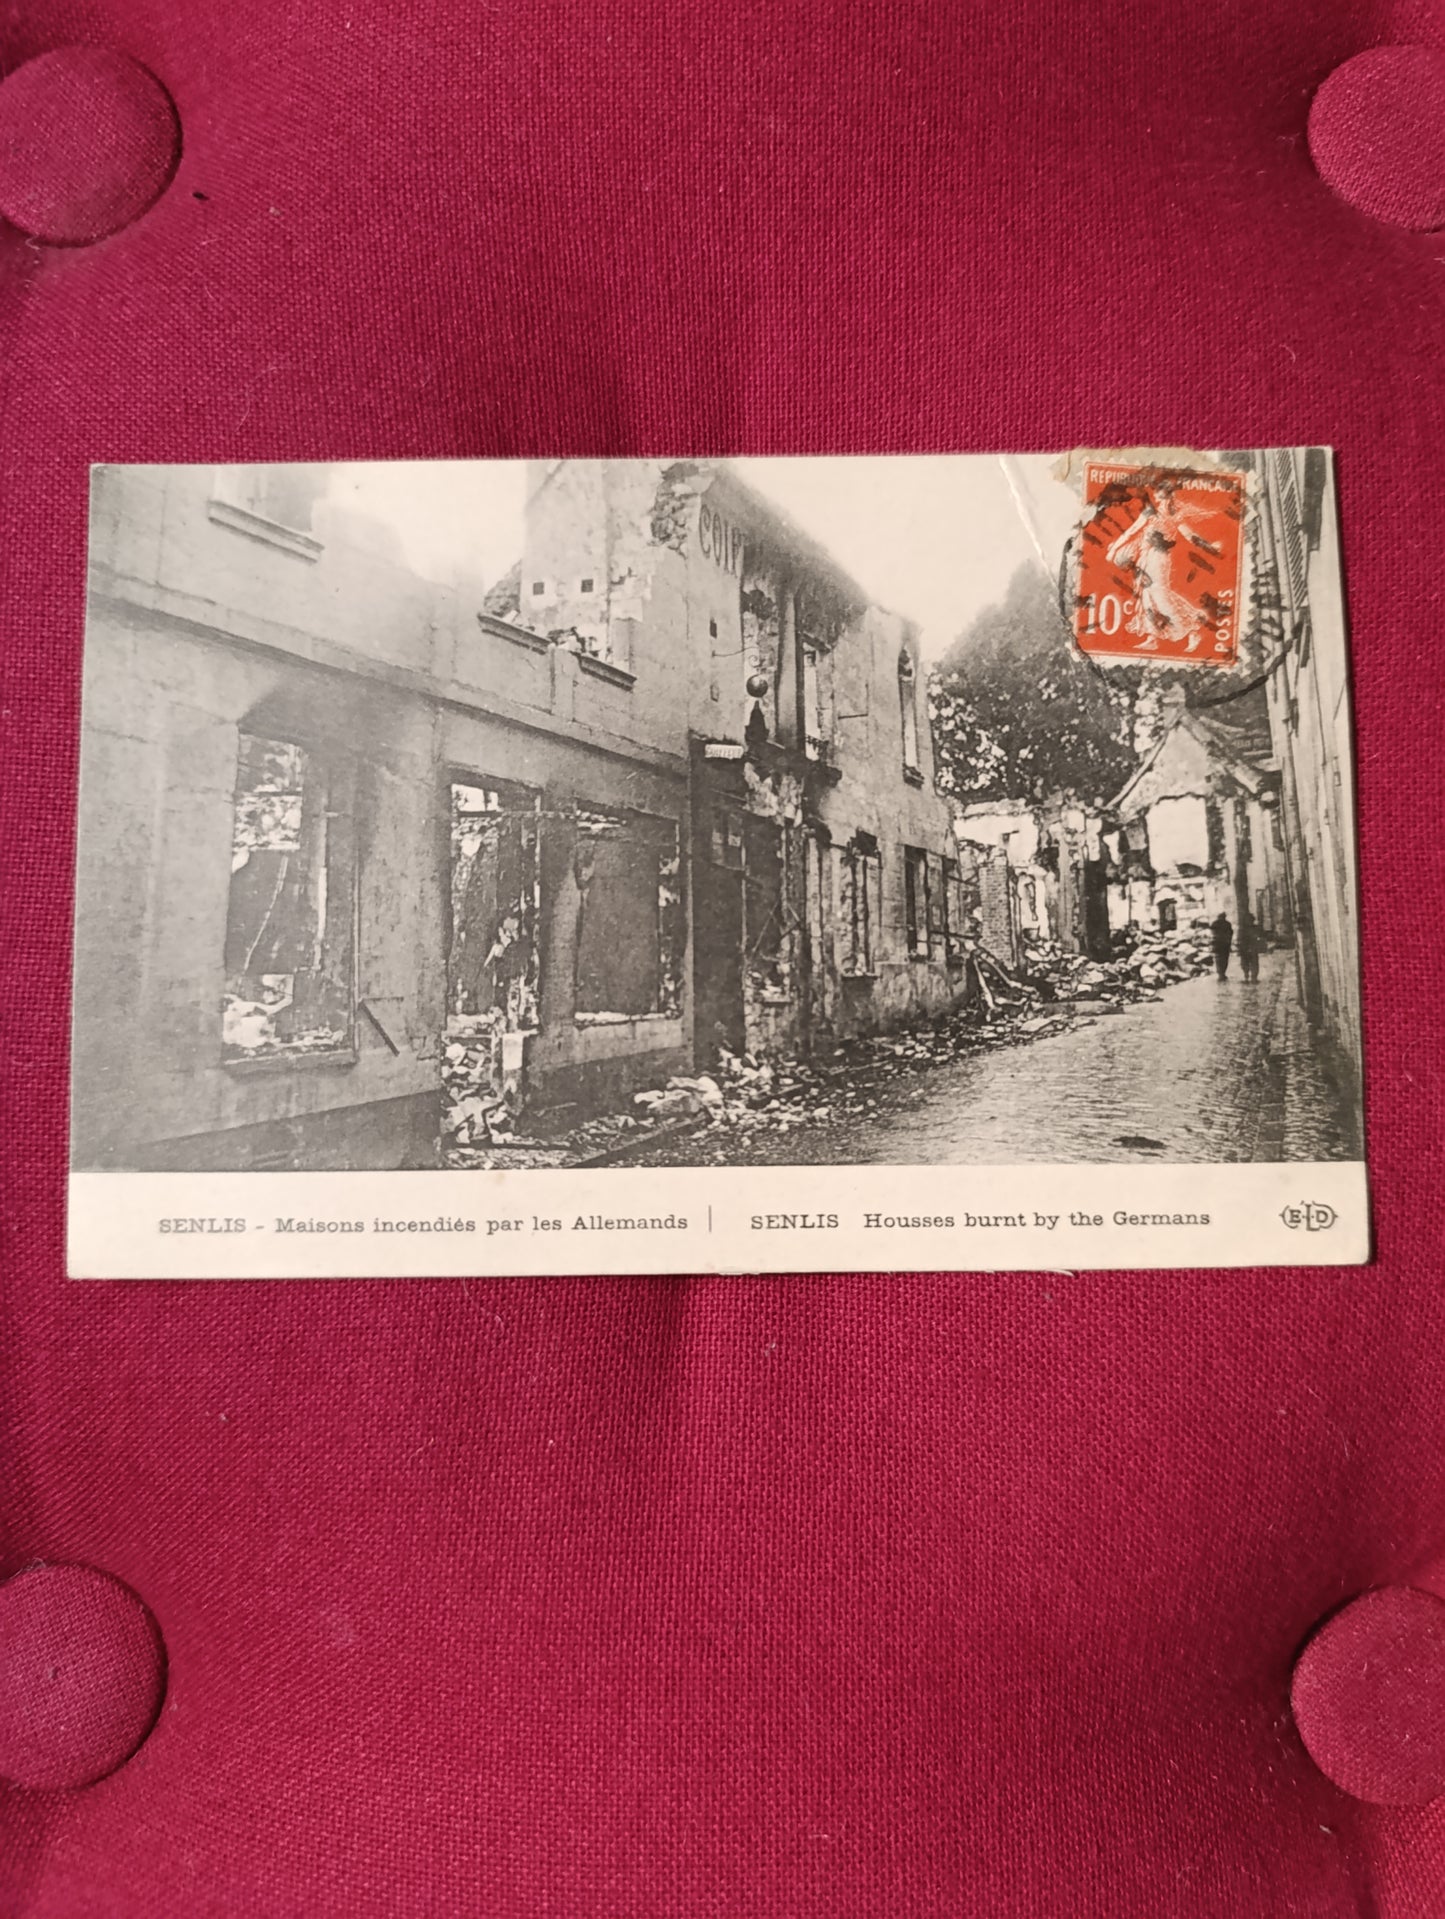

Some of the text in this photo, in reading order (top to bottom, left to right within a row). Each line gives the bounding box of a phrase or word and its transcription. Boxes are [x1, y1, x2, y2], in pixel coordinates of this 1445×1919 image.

[1214, 589, 1234, 652] POSTES
[159, 1218, 246, 1234] SENLIS
[275, 1217, 365, 1233] Maisons
[373, 1216, 476, 1232] incendiés
[486, 1219, 525, 1235] par
[532, 1215, 563, 1231] les
[571, 1214, 689, 1230] Allemands
[750, 1211, 1211, 1230] SENLIS Housses burnt by the Germans
